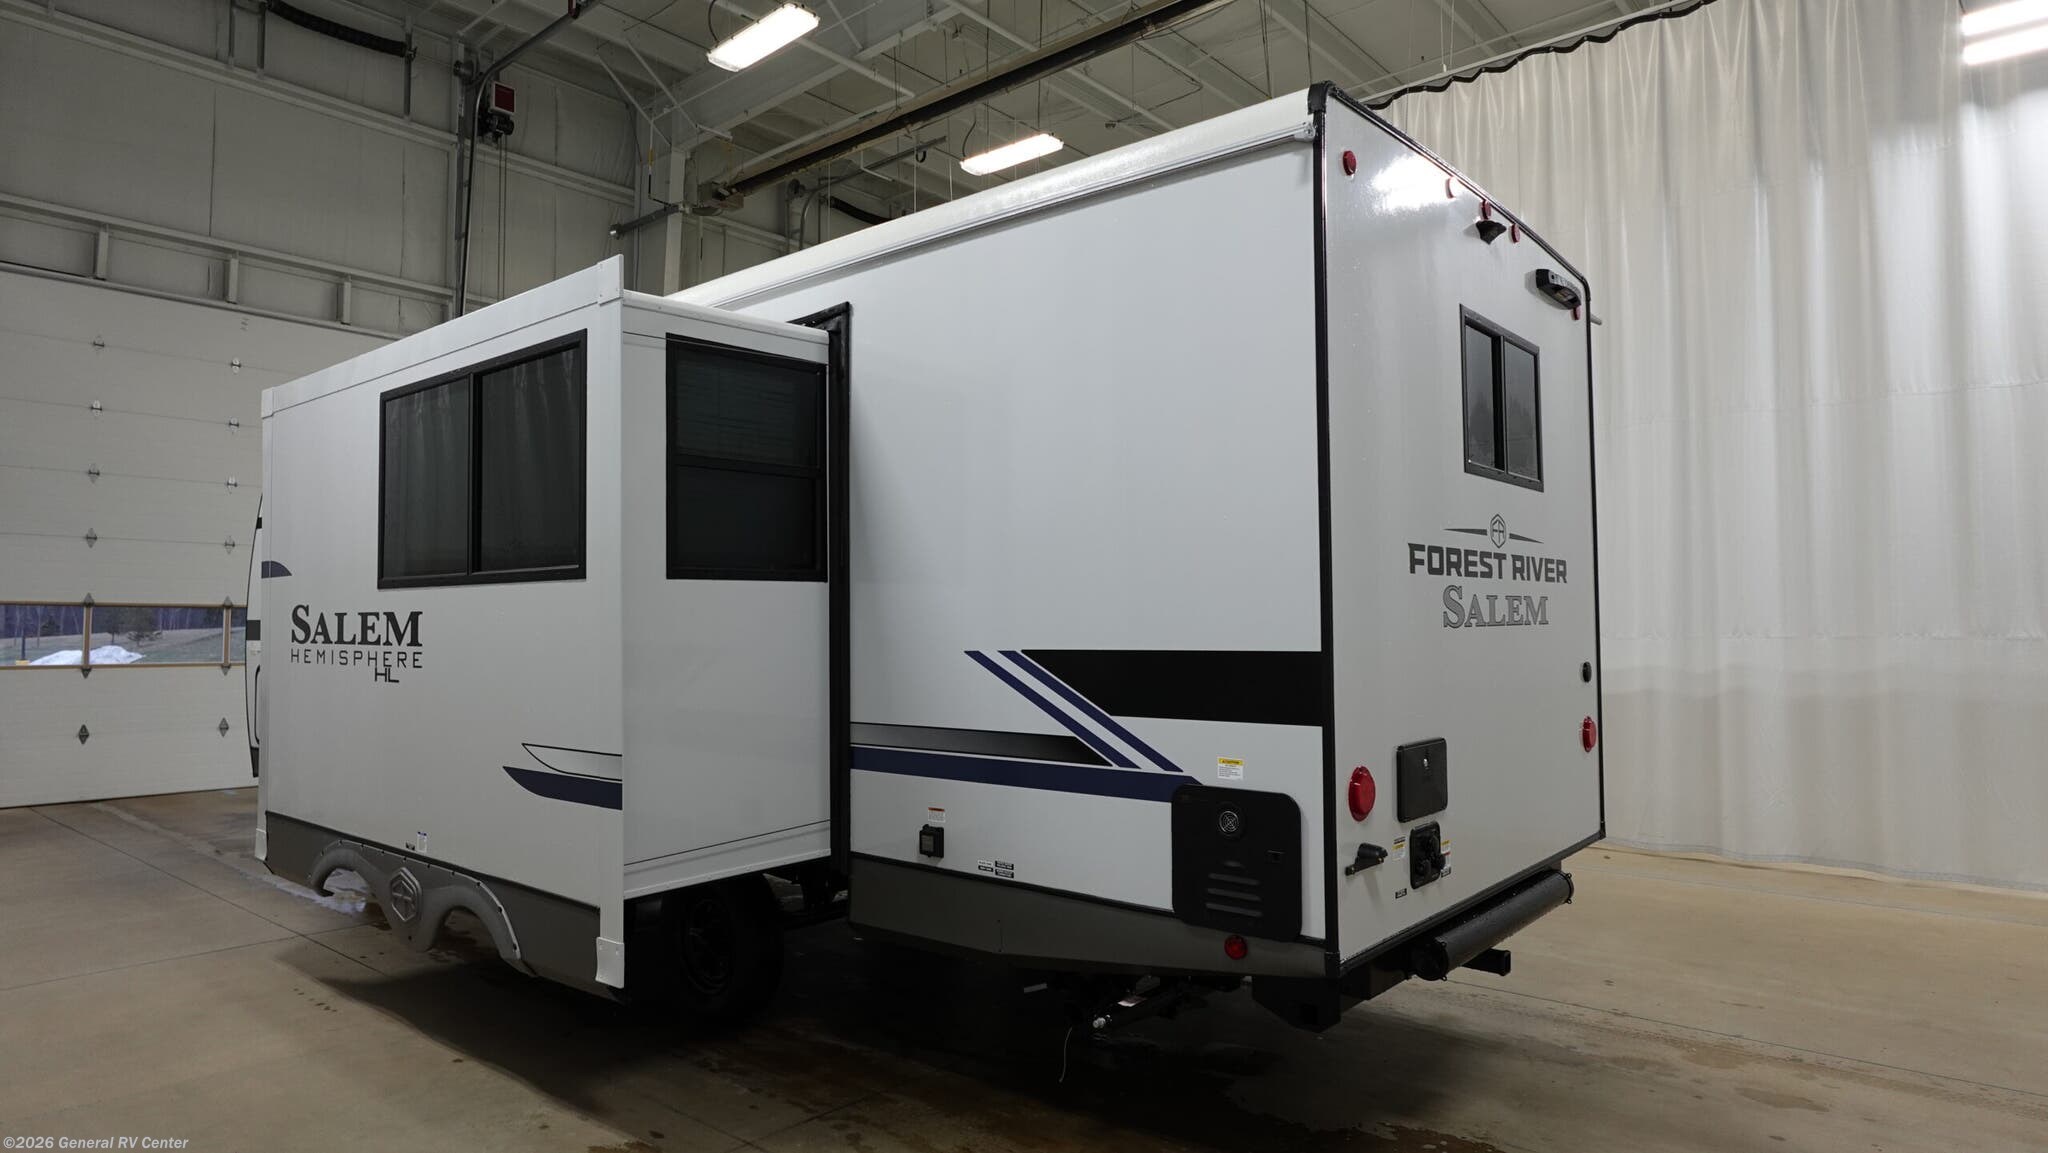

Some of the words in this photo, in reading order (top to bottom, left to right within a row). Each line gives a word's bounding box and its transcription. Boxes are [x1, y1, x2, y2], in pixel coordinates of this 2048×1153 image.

[1408, 543, 1507, 579] FOREST
[1511, 554, 1567, 583] RIVER
[291, 604, 423, 647] SALEM
[1443, 584, 1549, 629] SALEM
[291, 648, 423, 668] HEMISPHERE
[375, 667, 399, 683] HL
